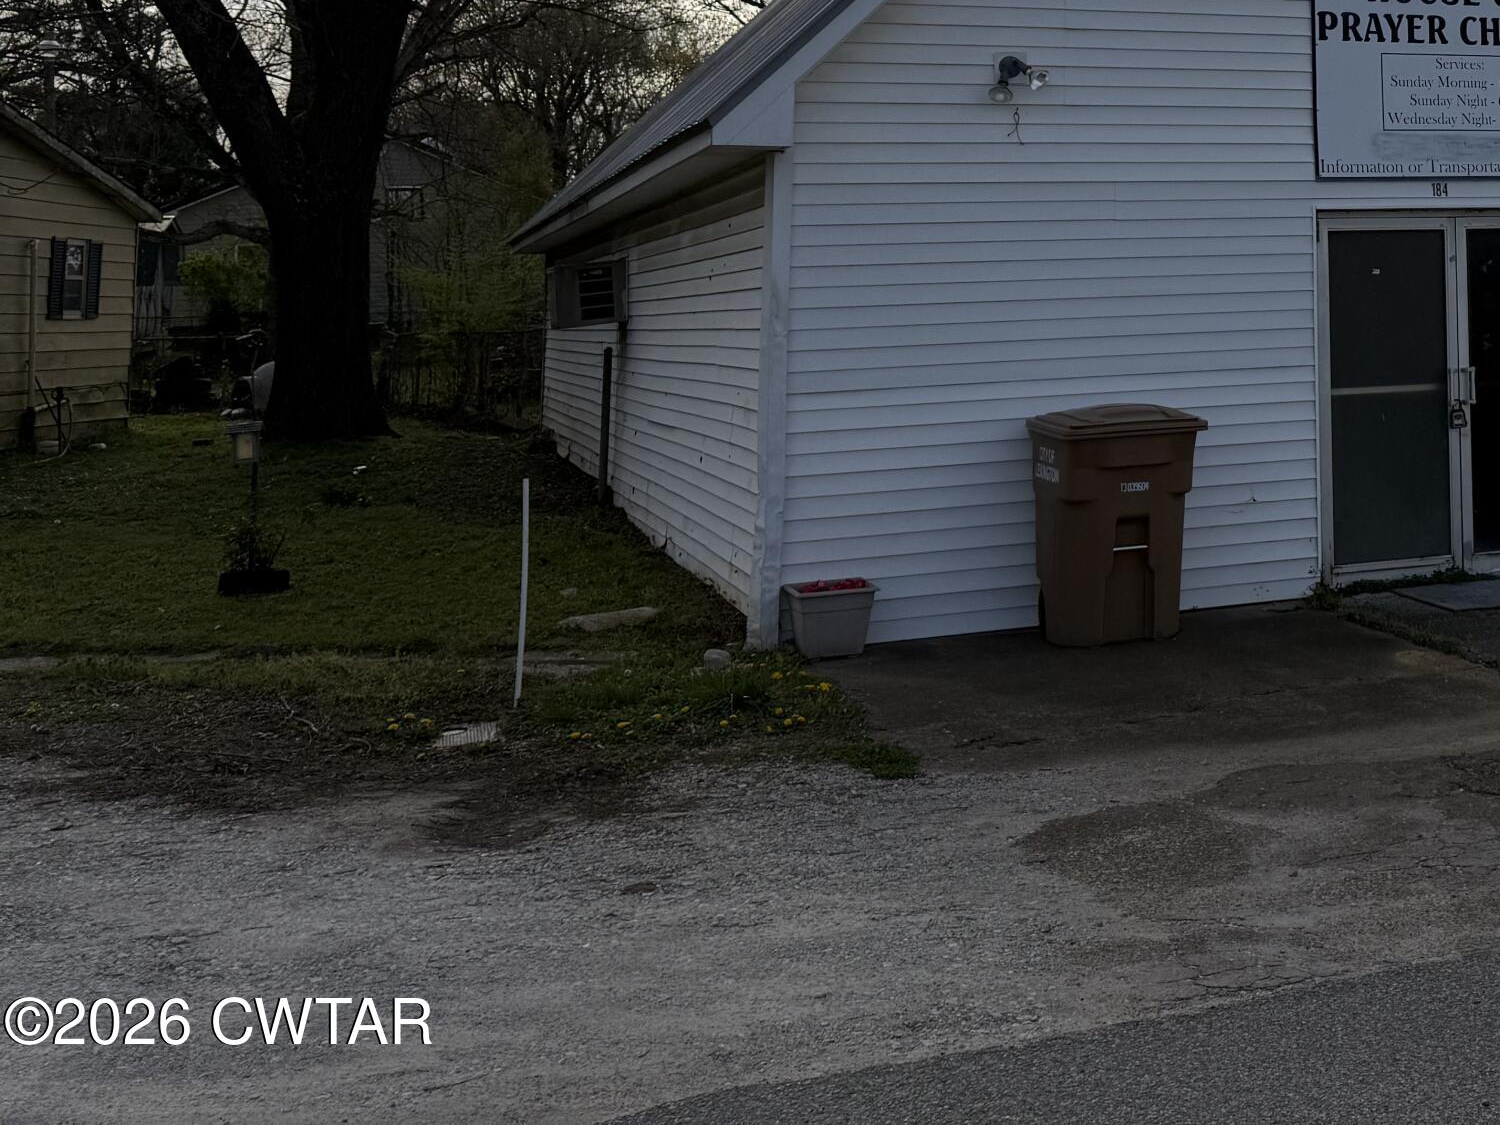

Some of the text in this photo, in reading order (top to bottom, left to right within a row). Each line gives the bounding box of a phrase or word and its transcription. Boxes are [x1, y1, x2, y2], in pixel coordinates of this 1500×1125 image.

[1316, 11, 1448, 44] PRAYER
[1435, 57, 1485, 71] Services:
[1390, 75, 1434, 90] Sunday
[1438, 75, 1487, 90] Morning
[1409, 94, 1453, 108] Sunday
[1457, 94, 1487, 108] Night
[1388, 112, 1458, 127] Wednesday
[1319, 158, 1403, 174] Information
[1407, 162, 1424, 174] or
[1431, 183, 1449, 197] 184
